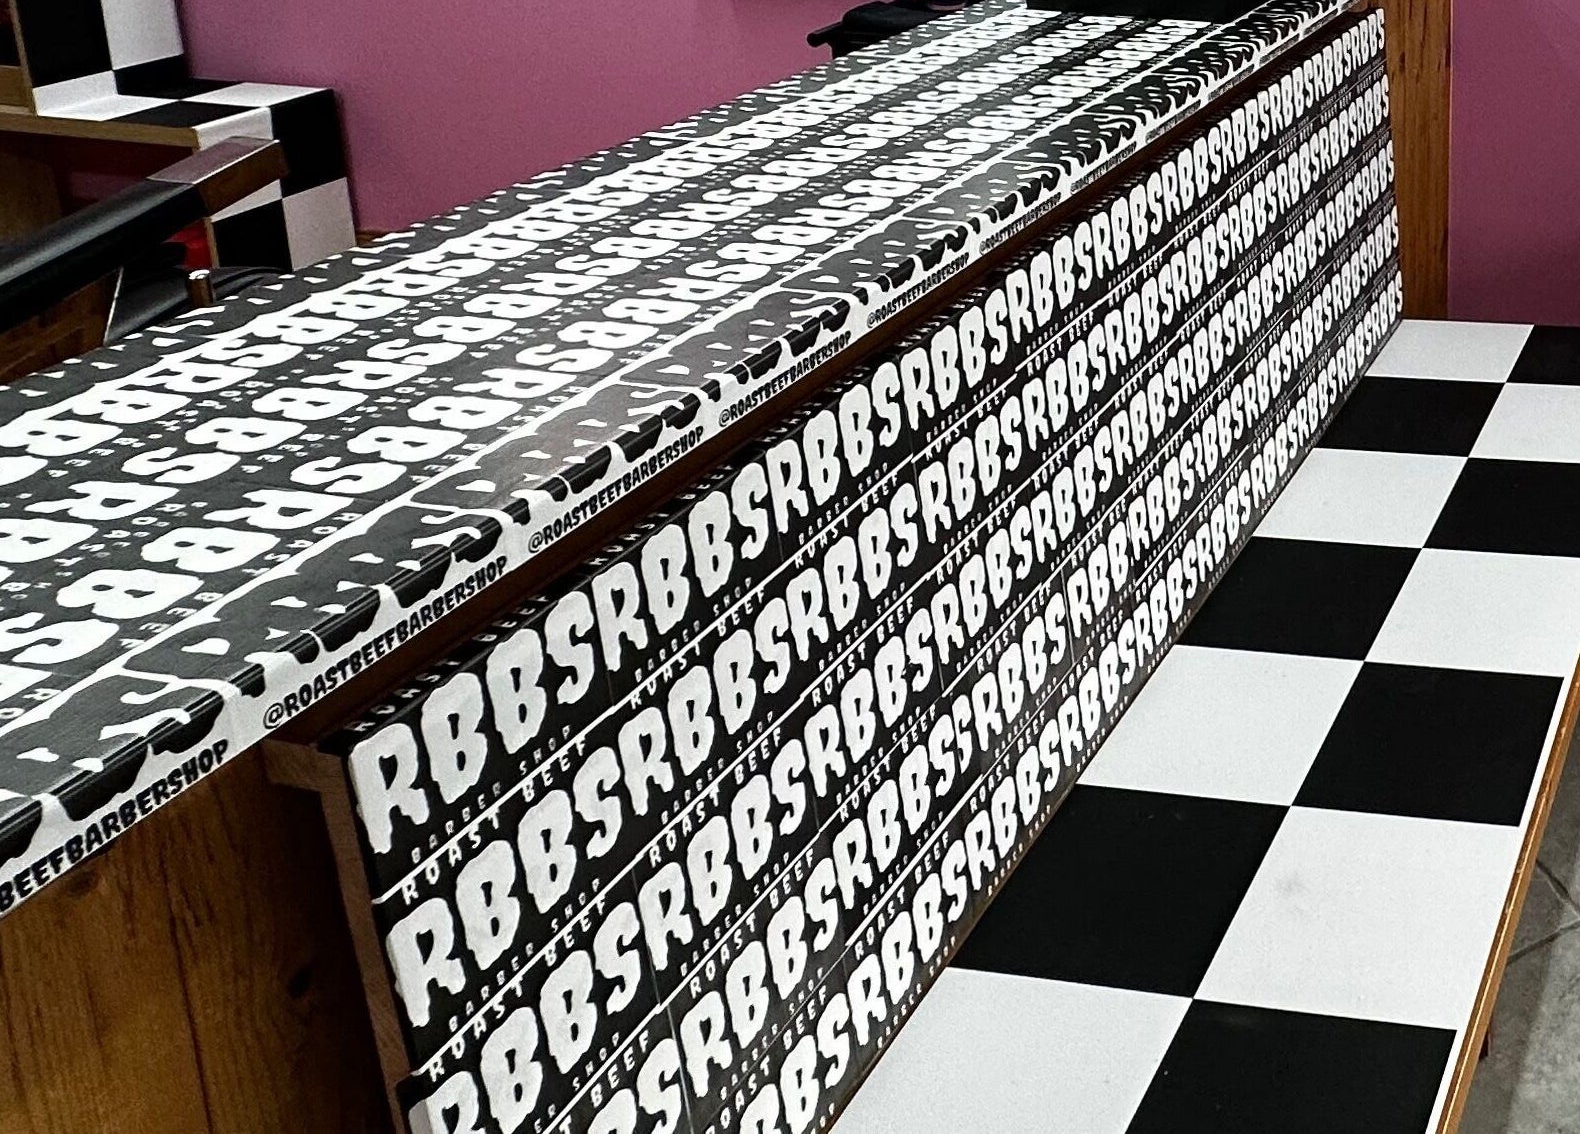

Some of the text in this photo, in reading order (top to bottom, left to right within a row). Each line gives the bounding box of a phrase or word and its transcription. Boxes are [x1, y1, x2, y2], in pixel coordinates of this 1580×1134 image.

[718, 330, 852, 428] @ROASTBEEFBARBERSHOP
[527, 425, 705, 554] @ROASTBEEFBARBERSHOP
[263, 555, 508, 730] @ROASTBEEFBARBERSHOP
[522, 735, 585, 801] BEEF
[649, 785, 719, 866] ROAST
[734, 727, 780, 784] BEEF
[811, 642, 865, 706] ROAST
[876, 596, 913, 643] BEEF
[590, 1030, 648, 1106] BEEF
[689, 912, 755, 997] ROAST
[769, 848, 813, 908] BEEF
[782, 985, 826, 1049] BEEF
[854, 886, 904, 959] ROAST
[914, 830, 948, 883] BEEF
